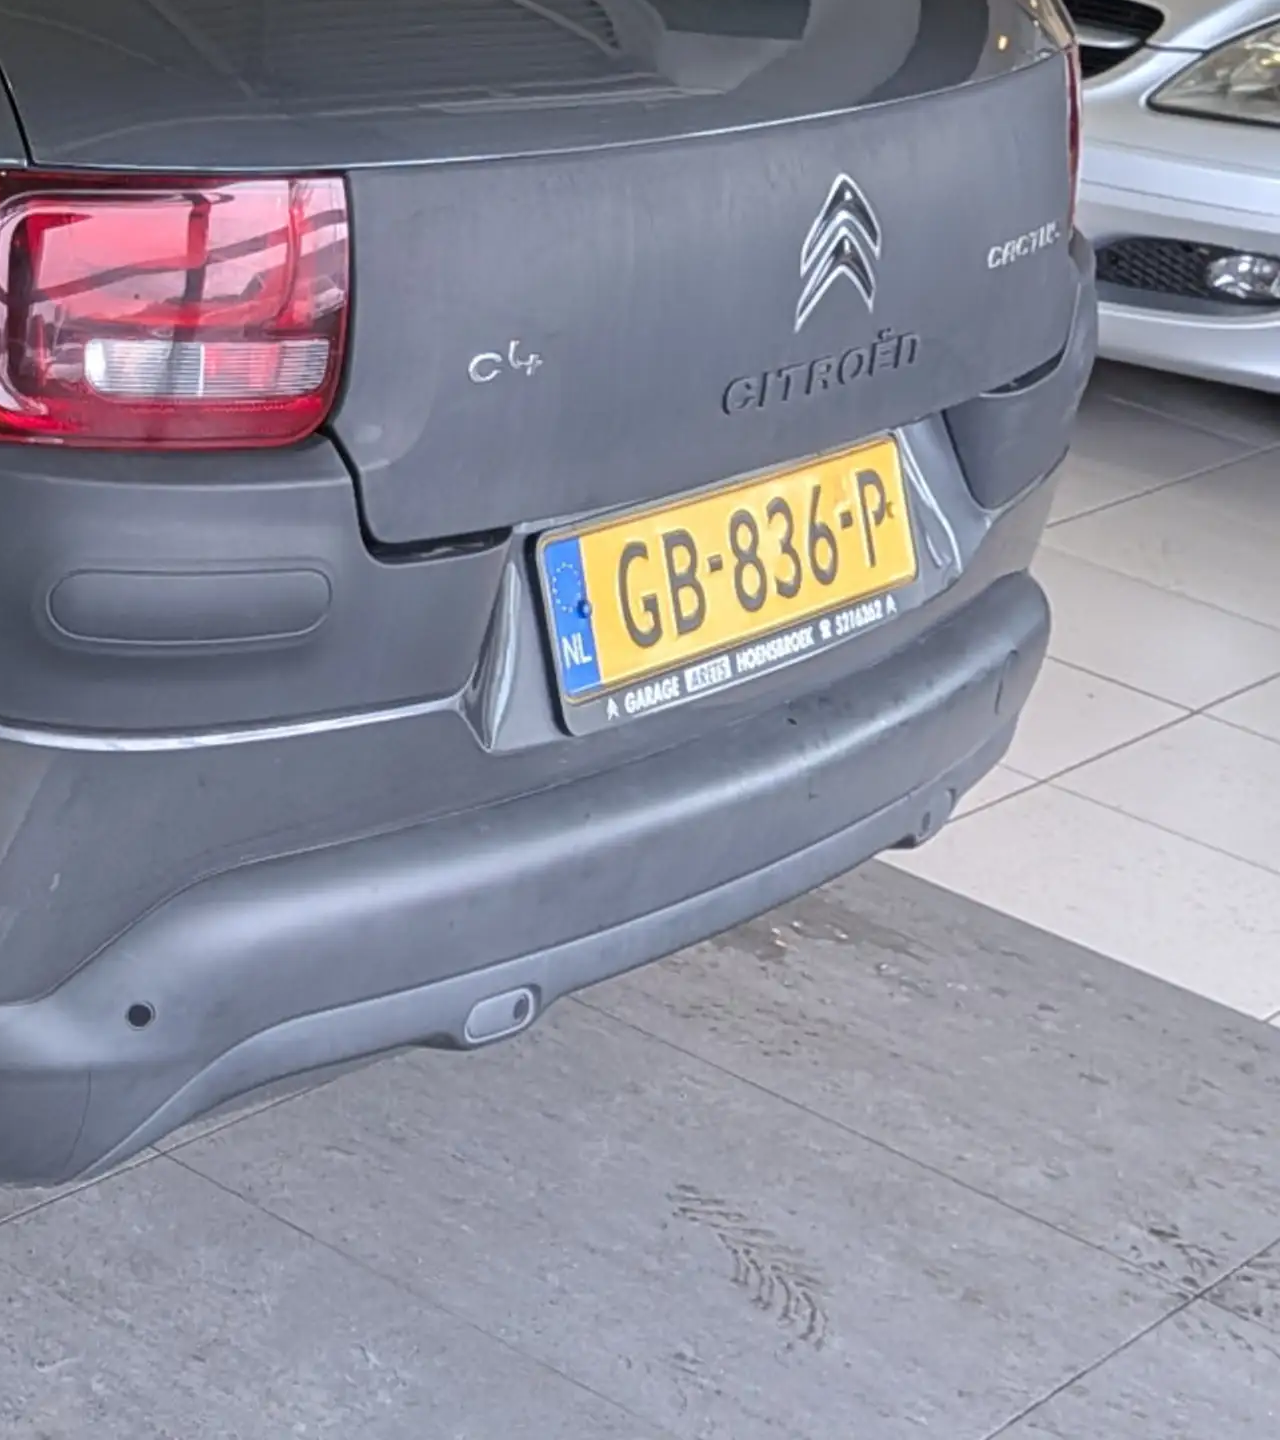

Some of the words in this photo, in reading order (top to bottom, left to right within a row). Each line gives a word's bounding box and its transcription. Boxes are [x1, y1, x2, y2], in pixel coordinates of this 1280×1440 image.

[467, 339, 543, 383] C4
[617, 467, 887, 649] GB-836-P
[560, 632, 592, 669] NL
[623, 676, 680, 714] GARAGE
